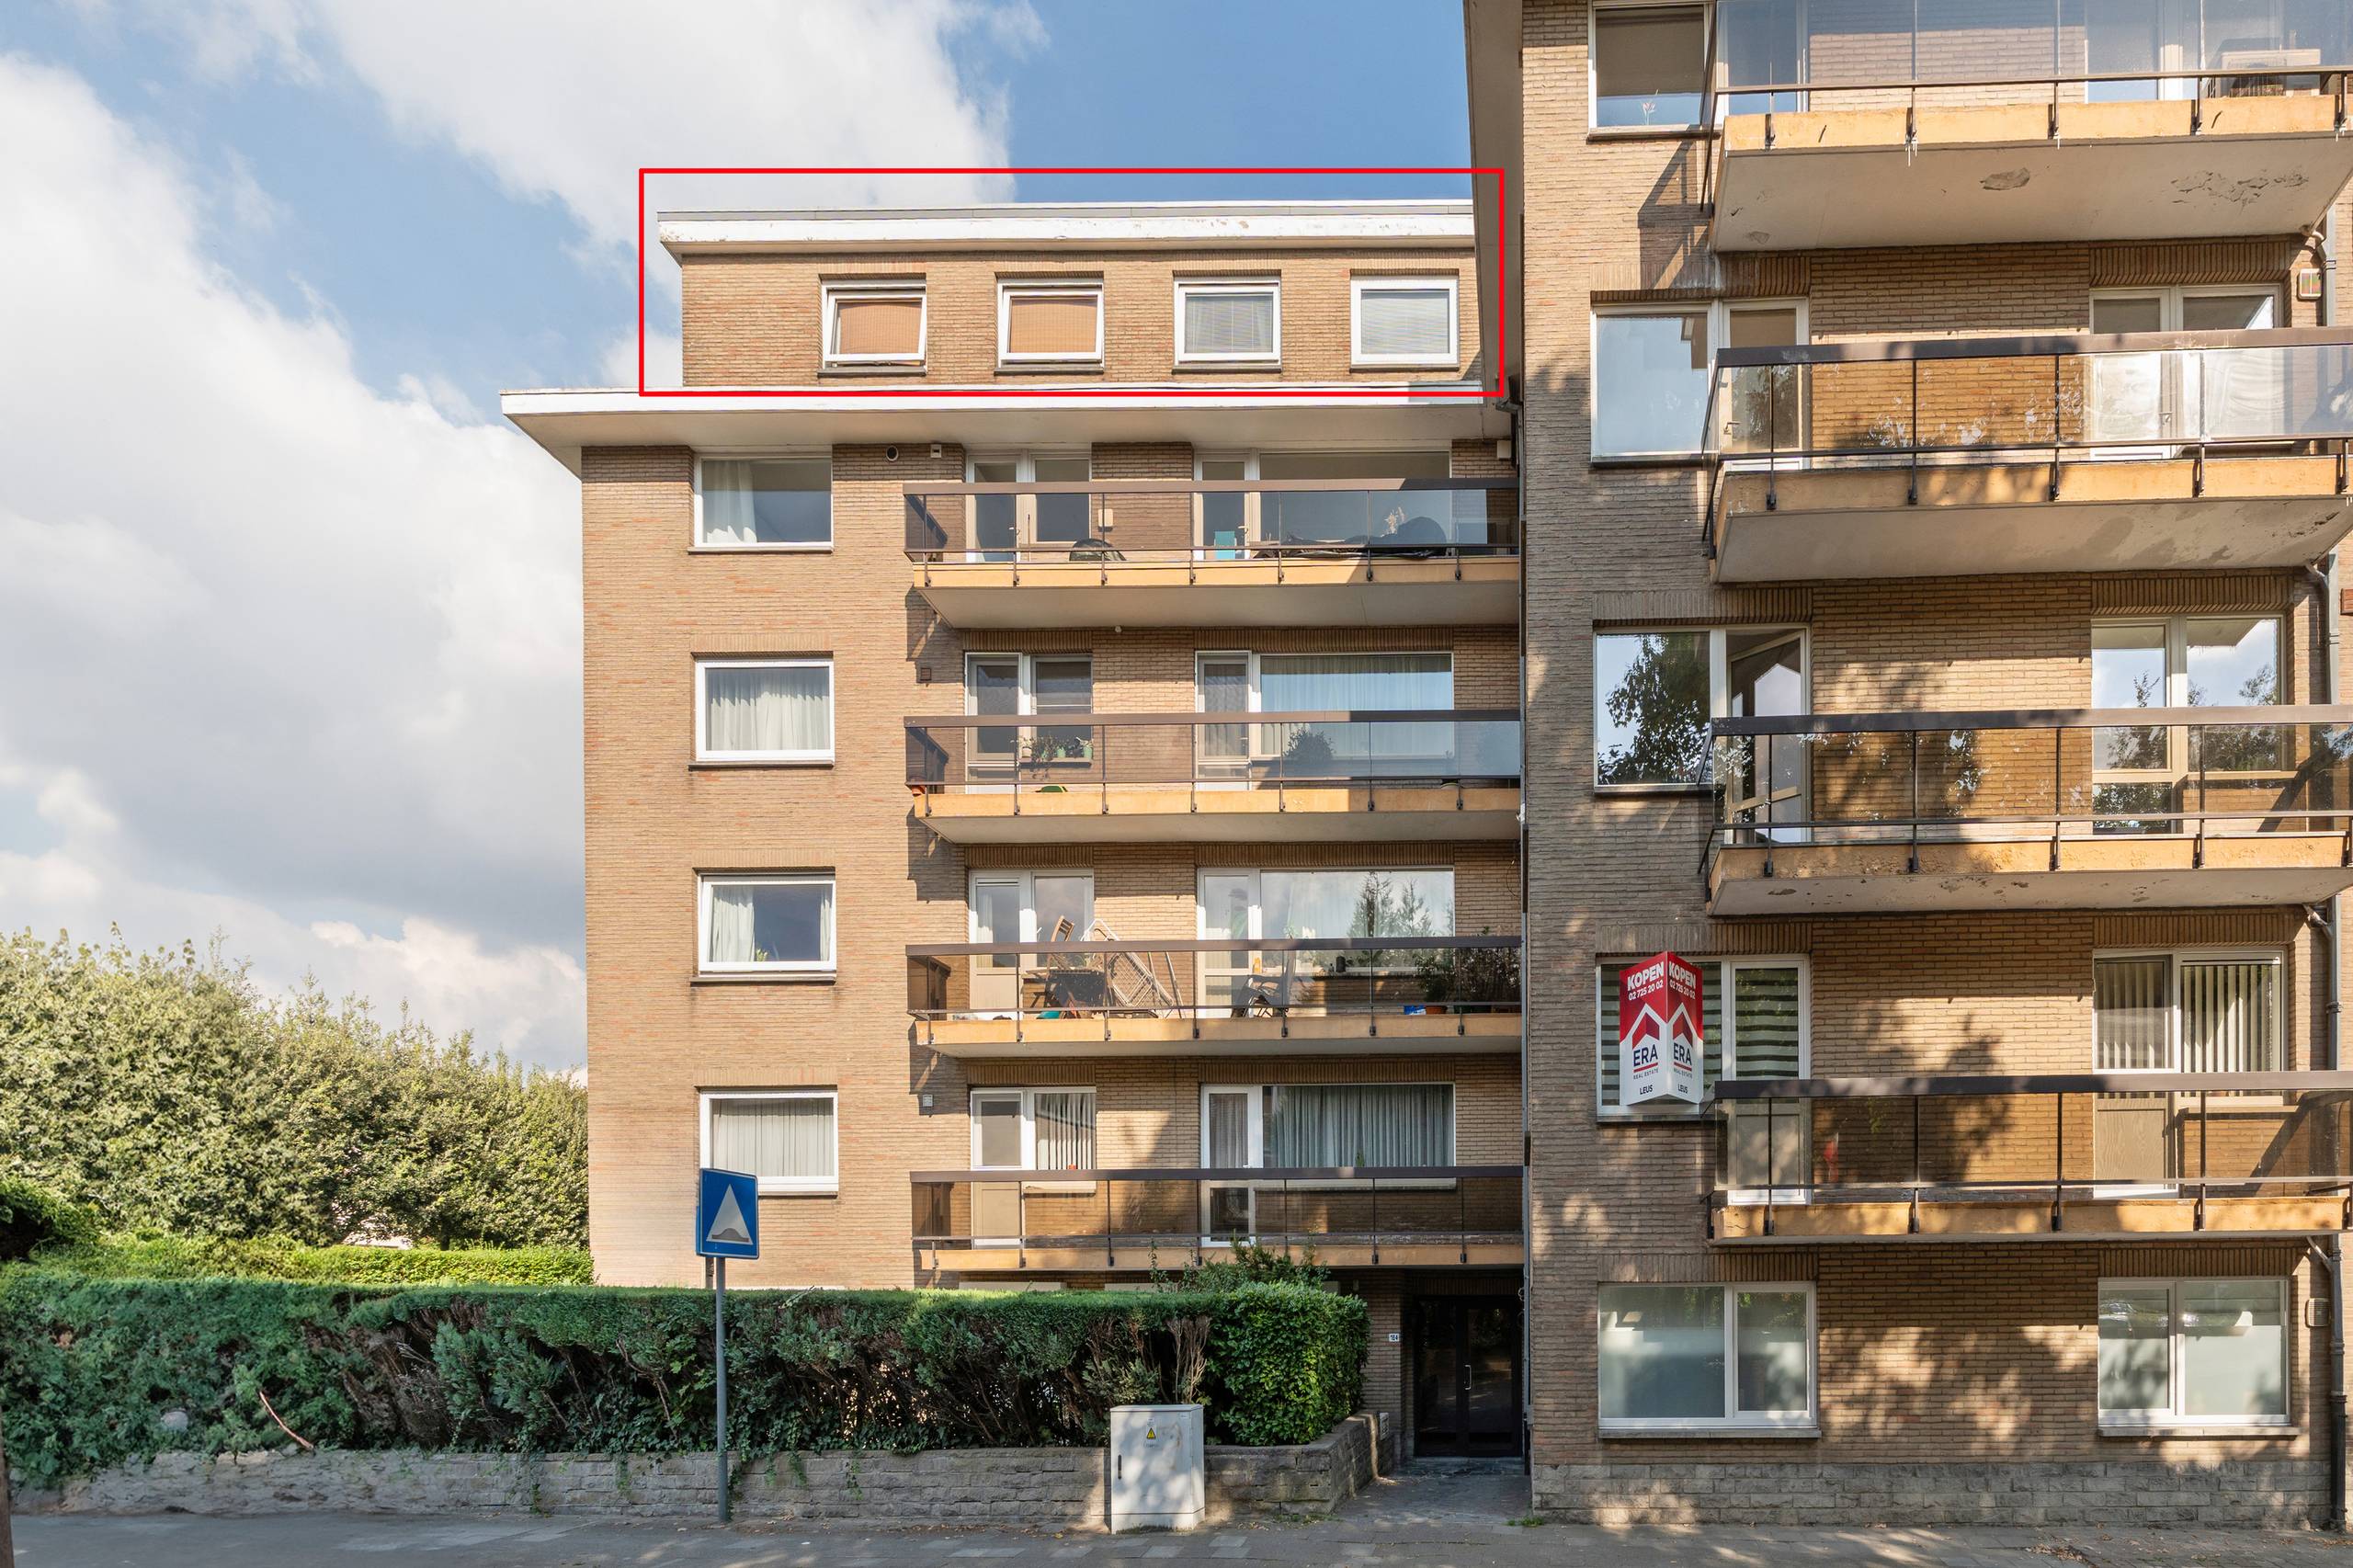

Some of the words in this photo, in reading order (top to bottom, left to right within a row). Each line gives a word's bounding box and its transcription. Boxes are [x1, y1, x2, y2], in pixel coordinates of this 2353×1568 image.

[1627, 961, 1665, 991] KOPEN
[1669, 960, 1697, 989] KOPEN
[1669, 979, 1676, 989] 02
[1628, 991, 1636, 1001] 02
[1637, 986, 1647, 998] 725
[1647, 983, 1655, 994] 20
[1655, 980, 1664, 989] 02
[1633, 1044, 1659, 1067] ERA
[1673, 1042, 1692, 1066] ERA
[1640, 1085, 1653, 1095] LEUS
[1677, 1084, 1688, 1094] LEUS
